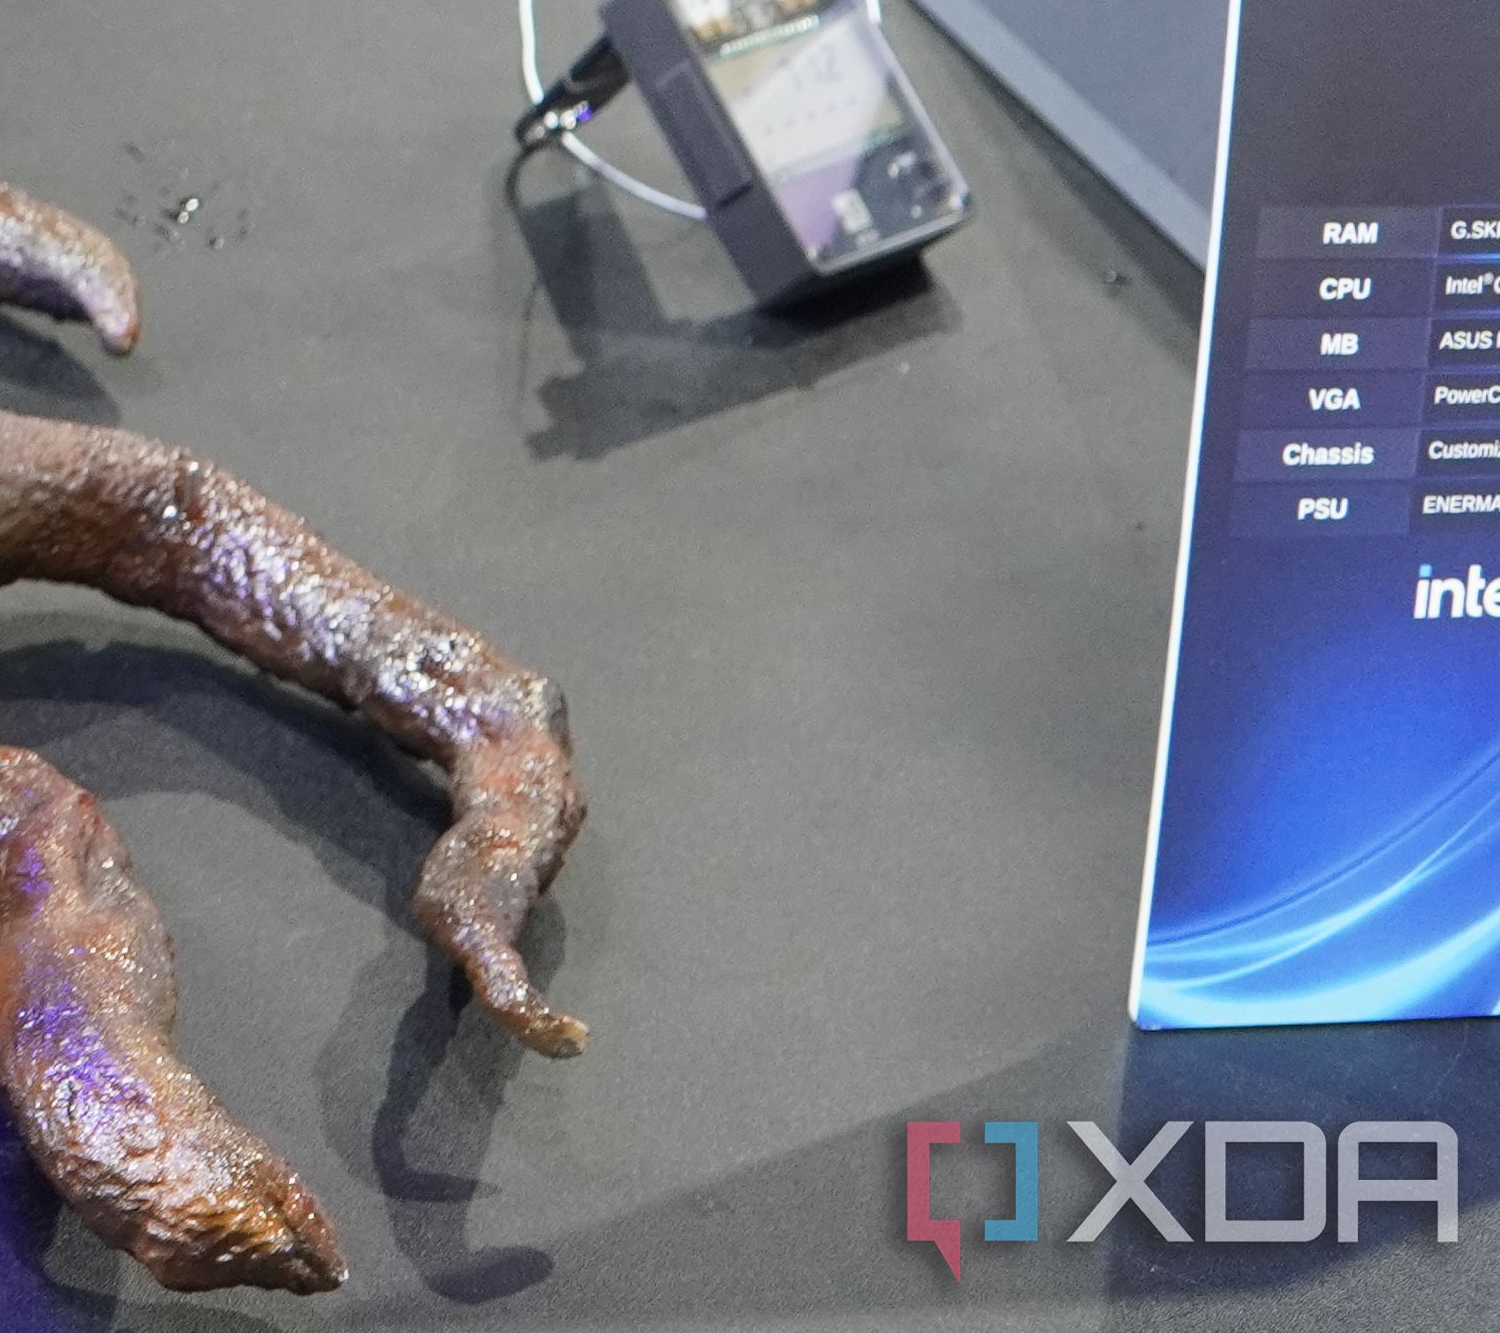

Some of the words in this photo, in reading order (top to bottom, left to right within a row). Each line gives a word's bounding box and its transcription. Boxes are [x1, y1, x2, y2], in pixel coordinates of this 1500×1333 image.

[1322, 222, 1378, 244] RAM
[1319, 278, 1371, 300] CPU
[1321, 333, 1359, 354] MB
[1439, 331, 1493, 350] ASUS
[1309, 388, 1361, 411] VGA
[1282, 442, 1375, 465] Chassis
[1428, 439, 1500, 460] Customi
[1297, 498, 1348, 520] PSU
